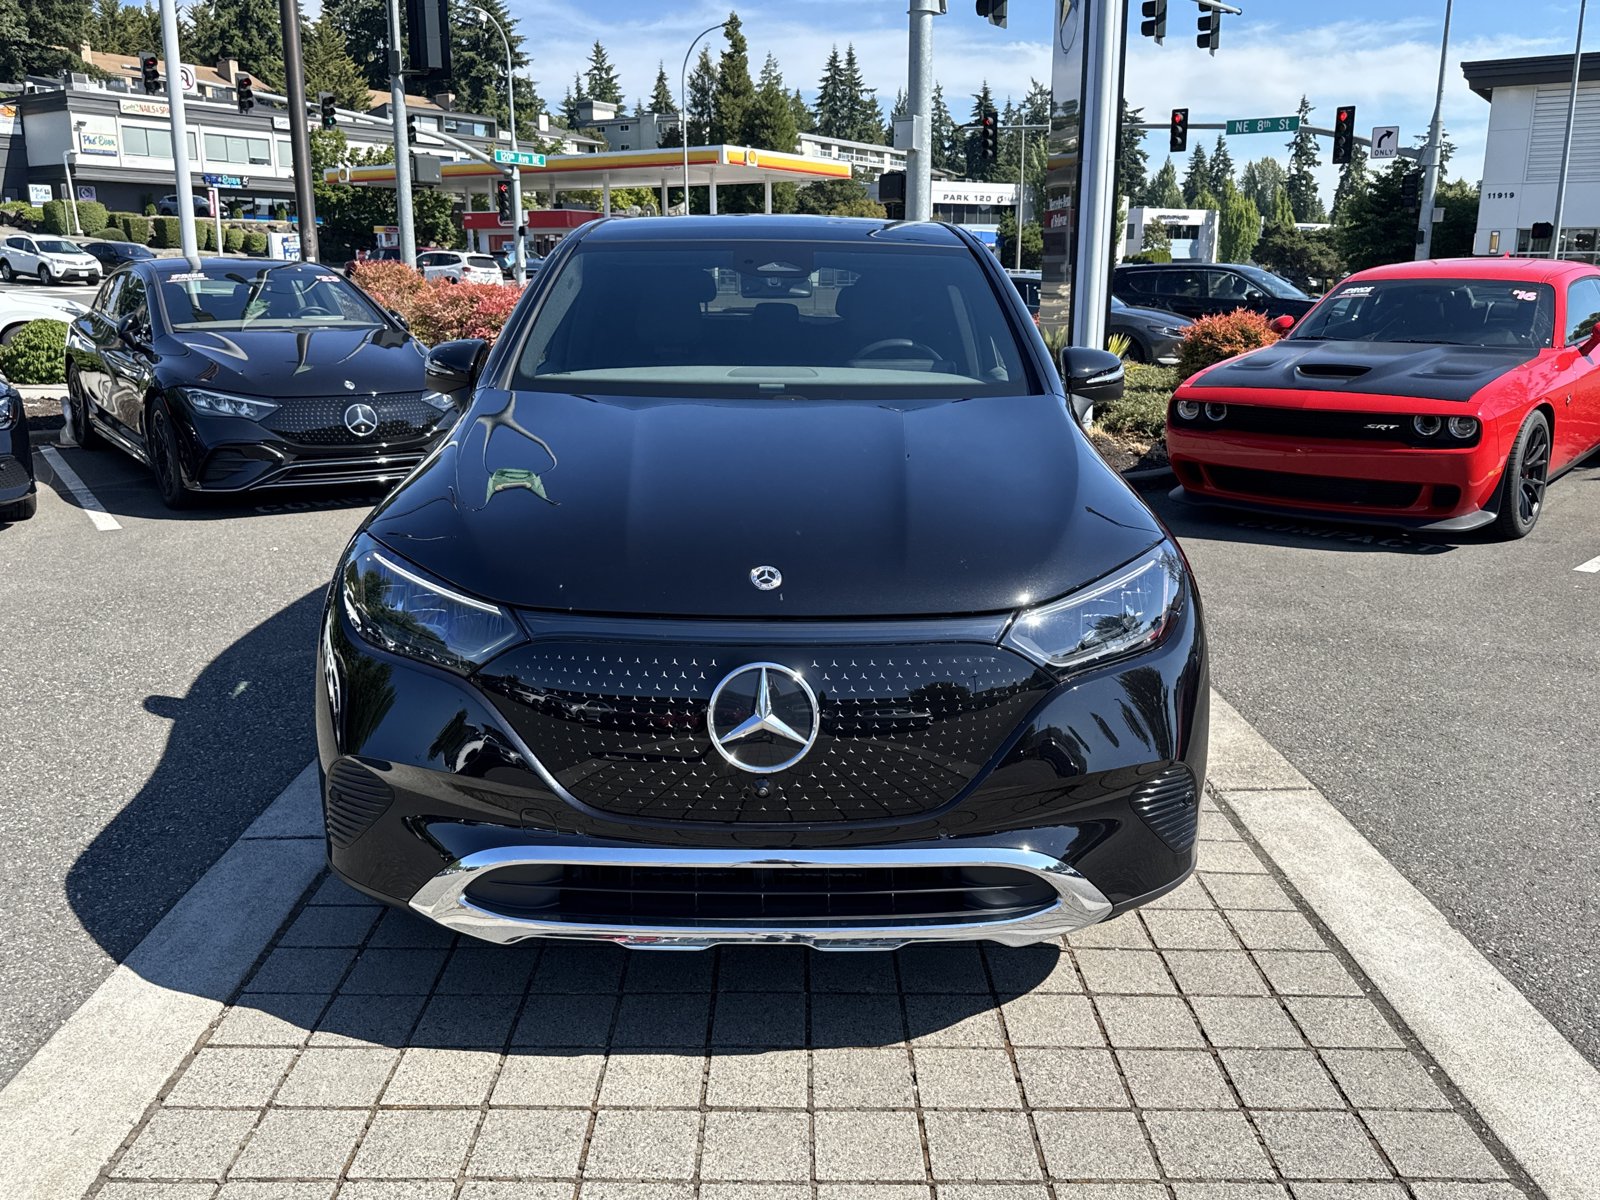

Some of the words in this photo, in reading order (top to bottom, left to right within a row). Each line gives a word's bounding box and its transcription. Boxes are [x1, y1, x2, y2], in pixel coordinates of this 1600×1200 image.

[1235, 121, 1249, 133] NE
[1257, 120, 1271, 131] 8th
[1278, 118, 1290, 130] St
[1374, 148, 1394, 156] ONLY
[501, 151, 515, 162] 120th
[519, 154, 530, 164] Ave
[532, 155, 540, 165] NE
[943, 194, 969, 202] PARK
[1487, 191, 1515, 199] 11919
[1363, 423, 1400, 431] SRT
[1237, 519, 1447, 552] COMPACT
